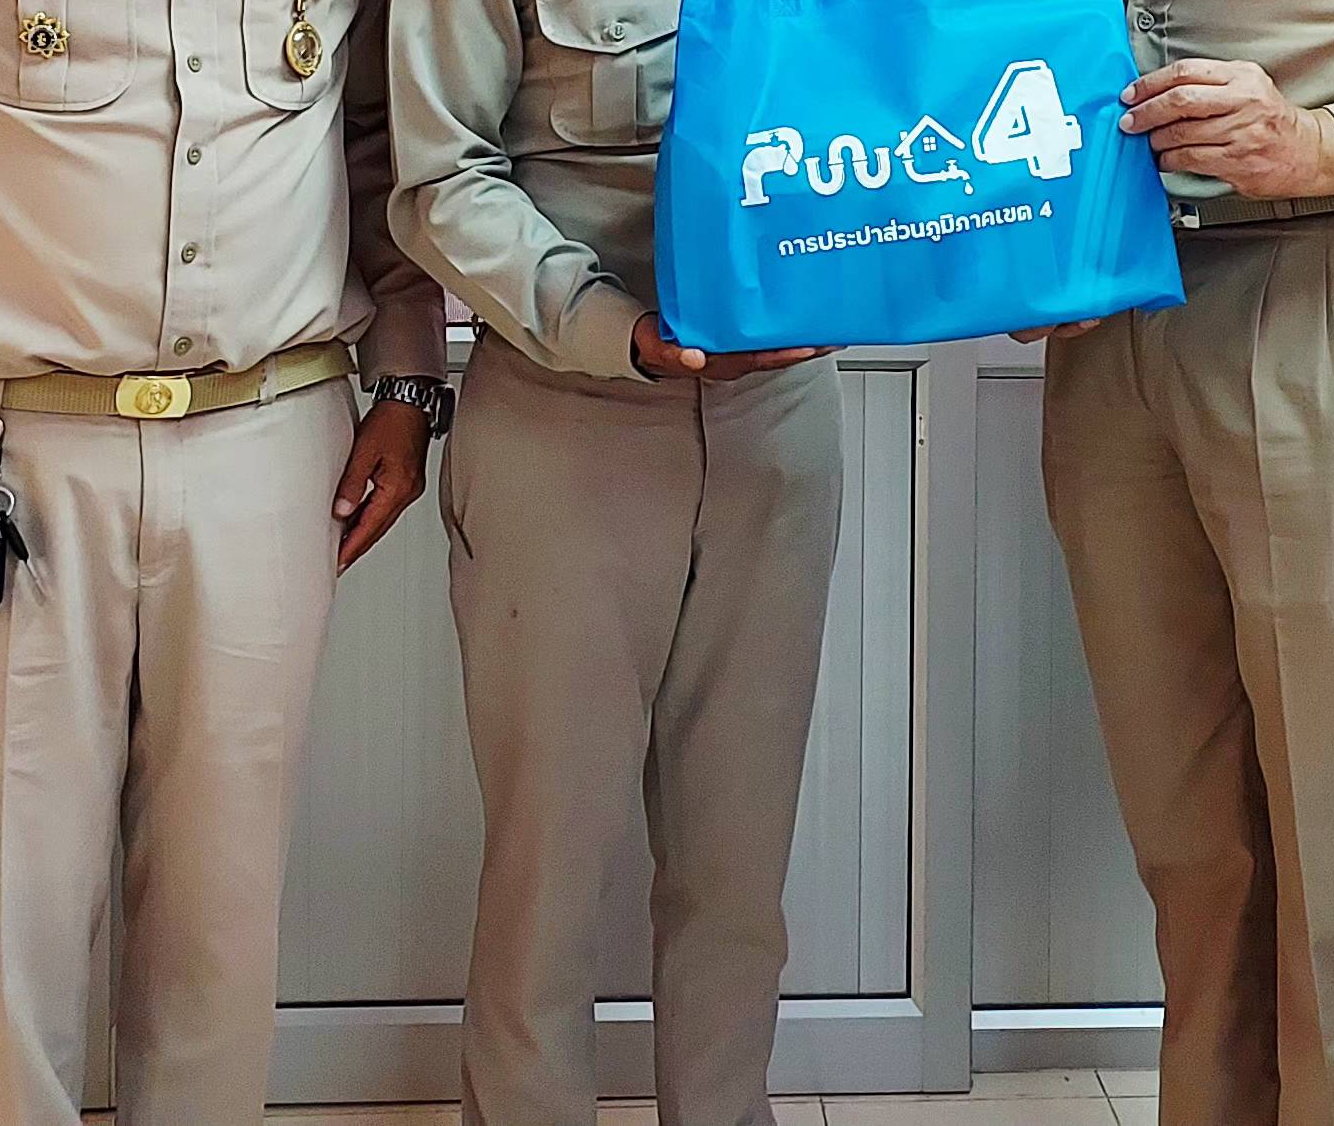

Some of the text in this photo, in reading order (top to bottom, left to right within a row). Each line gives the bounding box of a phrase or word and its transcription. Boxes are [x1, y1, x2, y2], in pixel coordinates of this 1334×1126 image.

[777, 200, 1053, 257] การประปาส่วนภูมิภาคเขต 4
